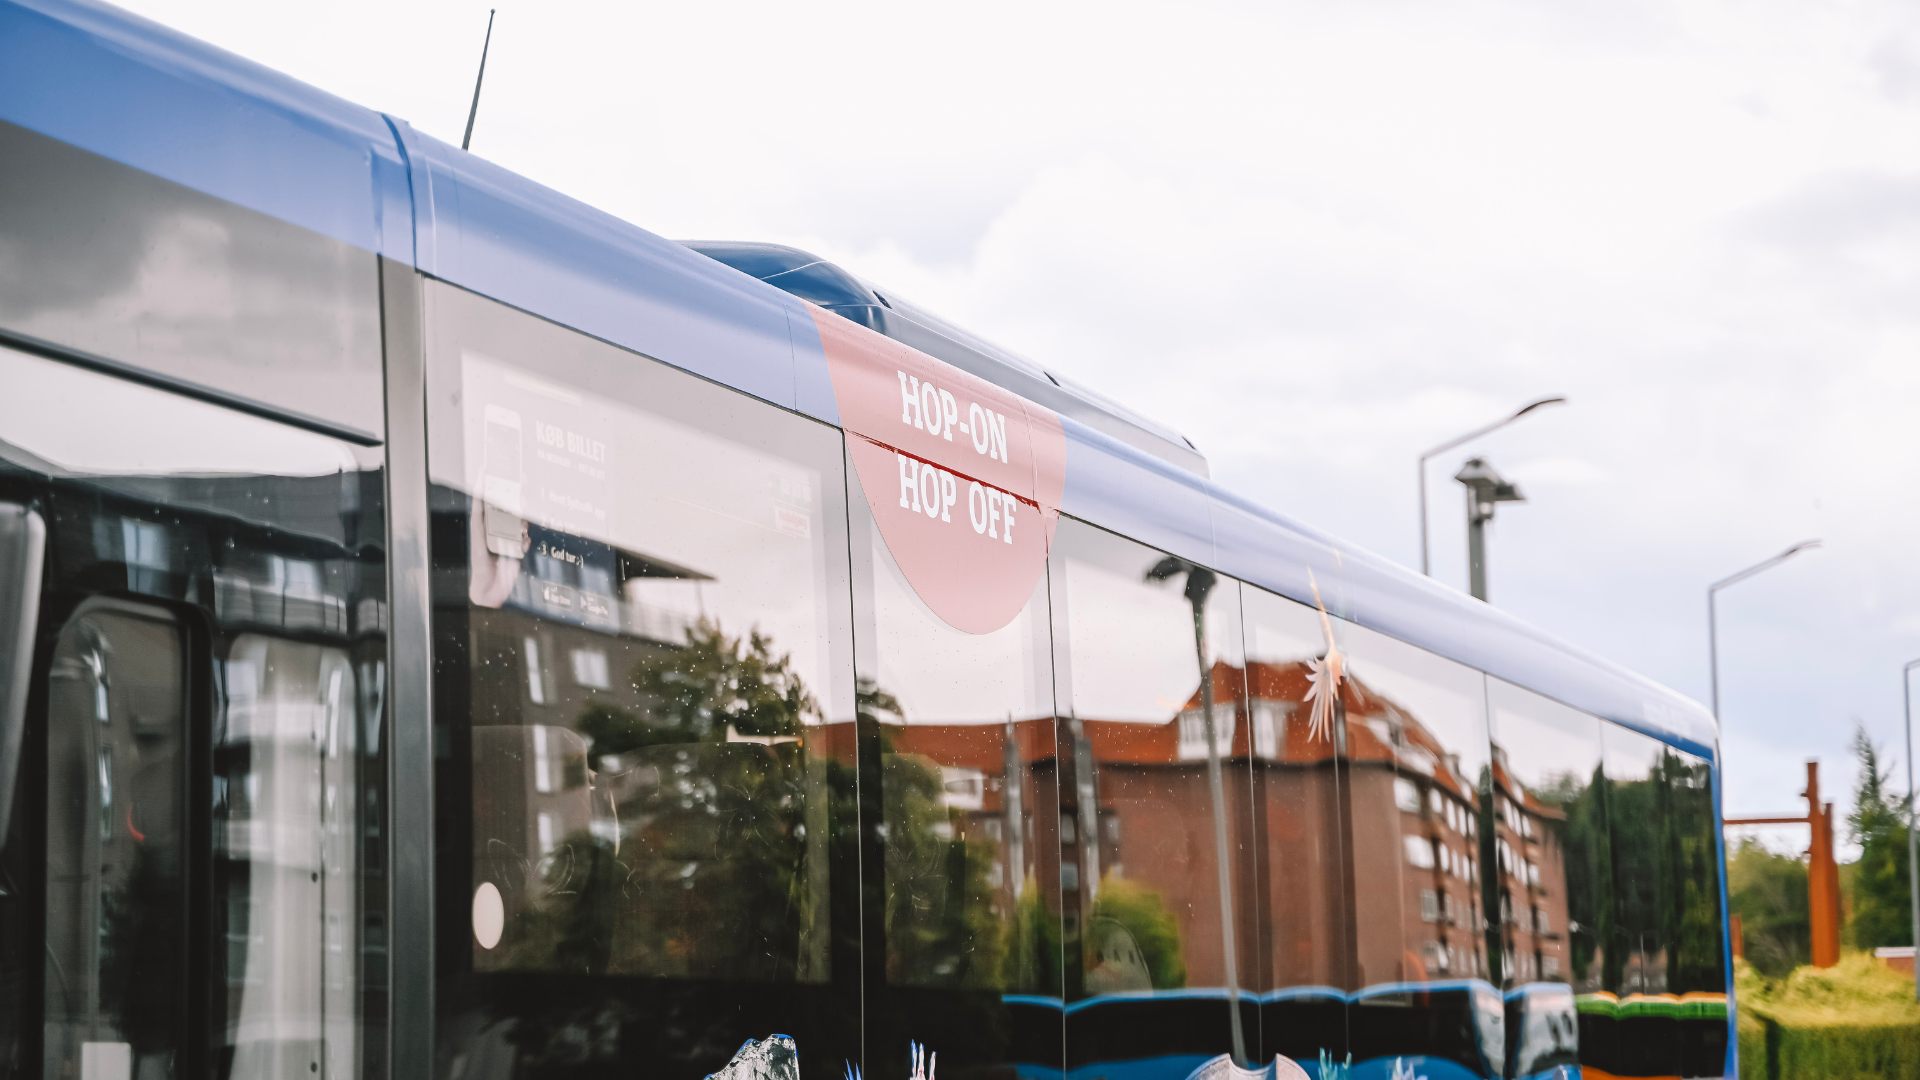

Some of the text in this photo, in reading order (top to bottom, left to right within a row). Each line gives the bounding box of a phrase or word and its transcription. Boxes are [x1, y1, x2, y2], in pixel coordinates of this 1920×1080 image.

[535, 420, 606, 464] KØB BILLET
[897, 370, 1008, 464] HOP-ON
[897, 453, 1017, 545] HOP OFF
[551, 546, 565, 561] God
[566, 551, 576, 563] tur
